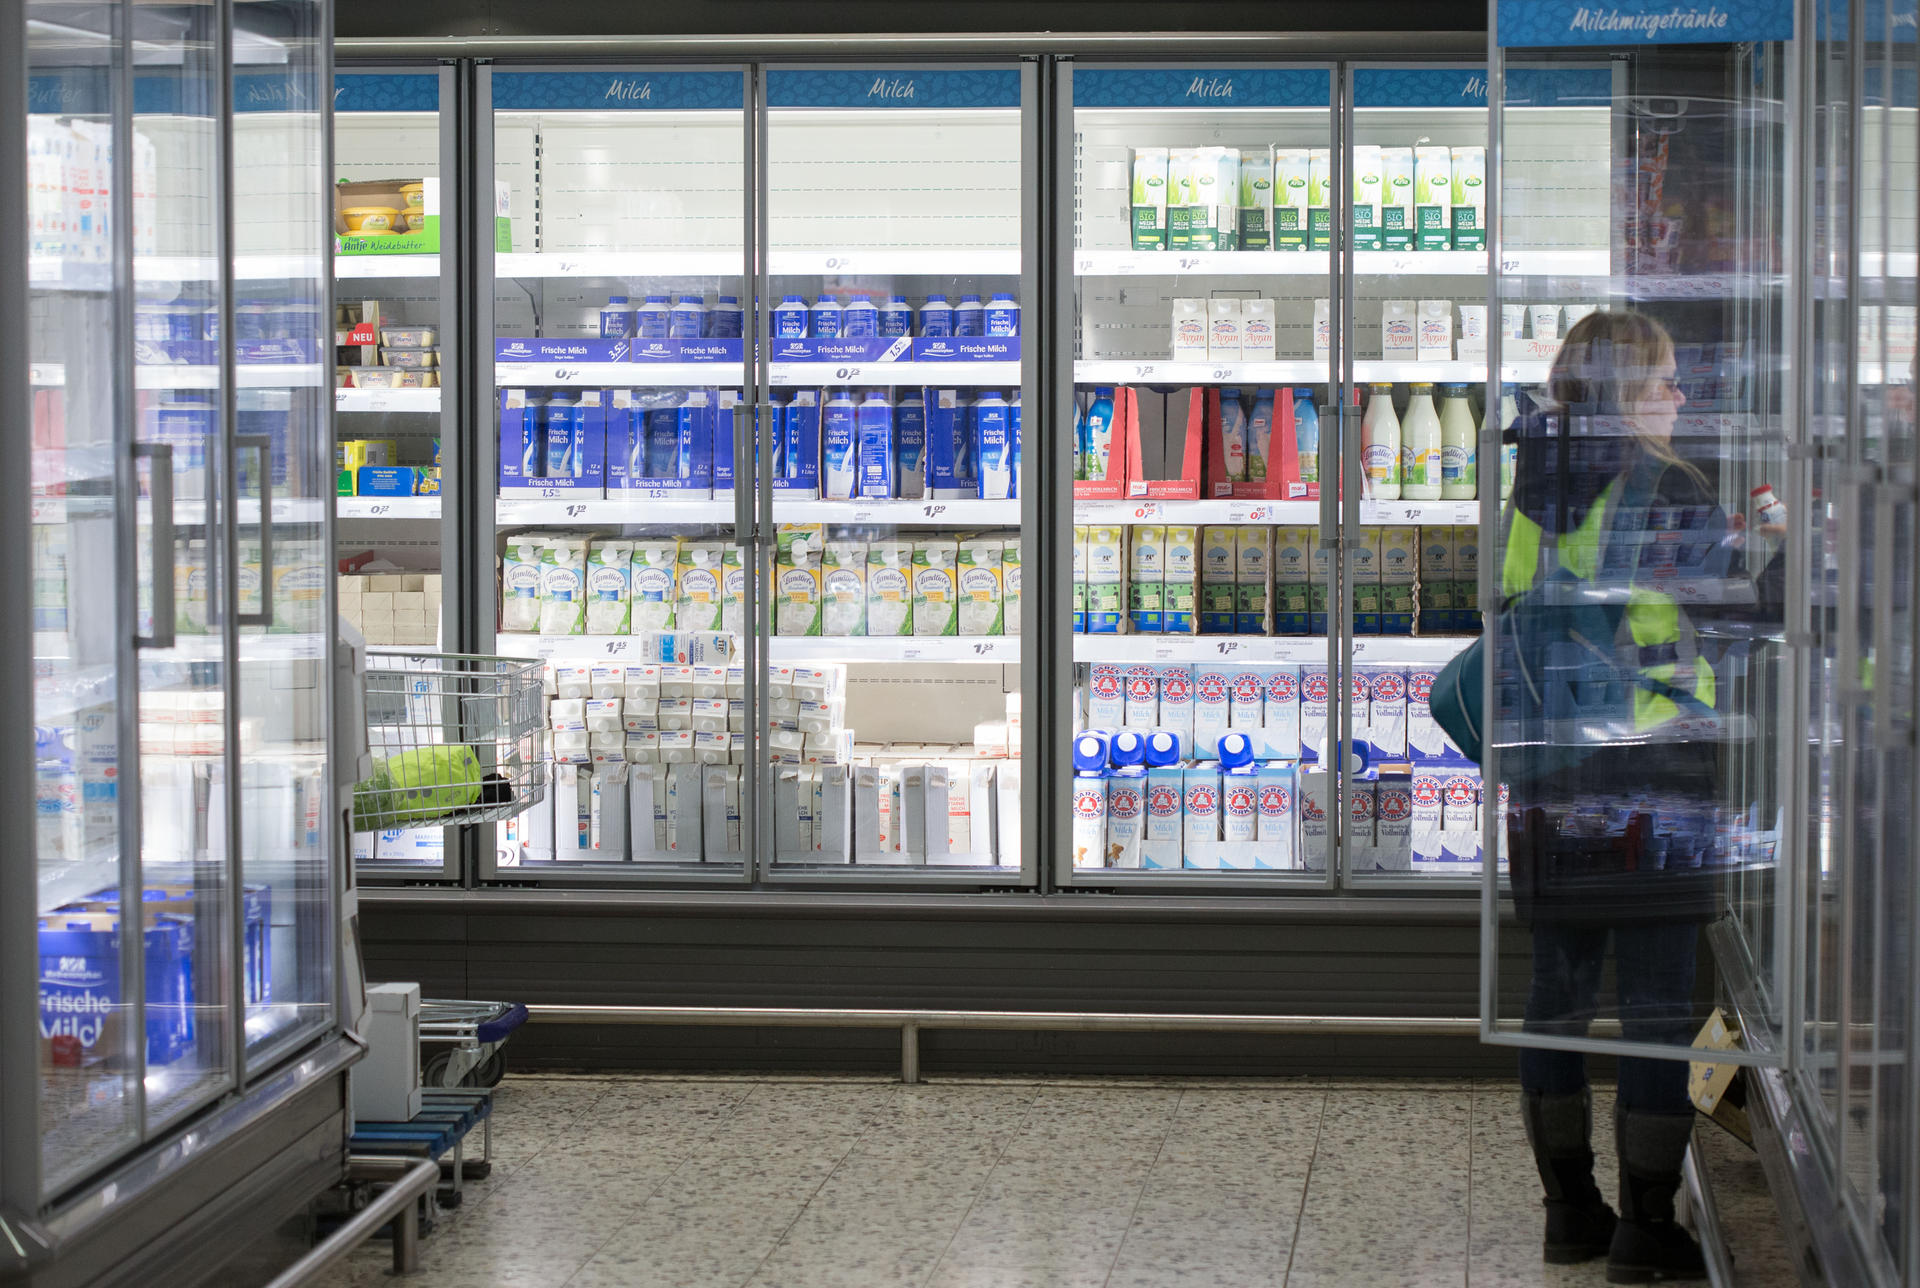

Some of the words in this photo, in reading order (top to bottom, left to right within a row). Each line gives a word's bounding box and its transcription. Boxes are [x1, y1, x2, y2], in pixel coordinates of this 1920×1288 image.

[1570, 7, 1728, 38] Milchmixgetränke
[605, 79, 651, 100] Milch
[868, 77, 914, 99] Milch
[1186, 76, 1233, 98] Milch
[1139, 213, 1155, 221] BIO
[1281, 214, 1297, 222] BIO
[1354, 211, 1371, 219] BIO
[1386, 213, 1403, 221] BIO
[1424, 213, 1440, 221] BIO
[1457, 213, 1474, 221] BIO
[344, 241, 368, 252] Antje
[370, 240, 423, 251] Weidebutter
[353, 333, 373, 342] NEU
[1176, 333, 1205, 345] Ayran
[1211, 333, 1239, 345] Ayran
[1245, 333, 1273, 345] Ayran
[1386, 333, 1414, 346] Ayran
[1420, 333, 1448, 345] Ayran
[541, 346, 565, 355] Frische
[567, 346, 588, 355] Milch
[680, 346, 706, 355] Frische
[707, 346, 727, 355] Milch
[817, 345, 843, 354] Frische
[844, 345, 865, 354] Milch
[960, 344, 986, 353] Frische
[987, 344, 1008, 353] Milch
[548, 436, 569, 444] Milch
[828, 437, 849, 445] Milch
[901, 436, 922, 445] Milch
[983, 436, 1004, 445] Milch
[528, 479, 554, 487] Frische
[555, 479, 575, 487] Milch
[1094, 687, 1121, 698] MARKE
[1128, 690, 1155, 701] MARKE
[1163, 690, 1190, 702] MARKE
[1199, 691, 1227, 702] MARKE
[1268, 690, 1295, 702] MARKE
[1373, 690, 1402, 701] MARKE
[1376, 709, 1403, 718] Vollmilch
[1446, 794, 1473, 806] MARKE
[1110, 805, 1139, 817] MARKE
[1149, 803, 1178, 815] MARKE
[1188, 803, 1217, 814] MARKE
[1228, 804, 1255, 815] MARKE
[1260, 803, 1288, 815] MARKE
[1446, 814, 1473, 822] Vollmilch
[1115, 826, 1133, 834] Milch
[1153, 824, 1173, 832] Milch
[1381, 829, 1410, 837] Vollmilch
